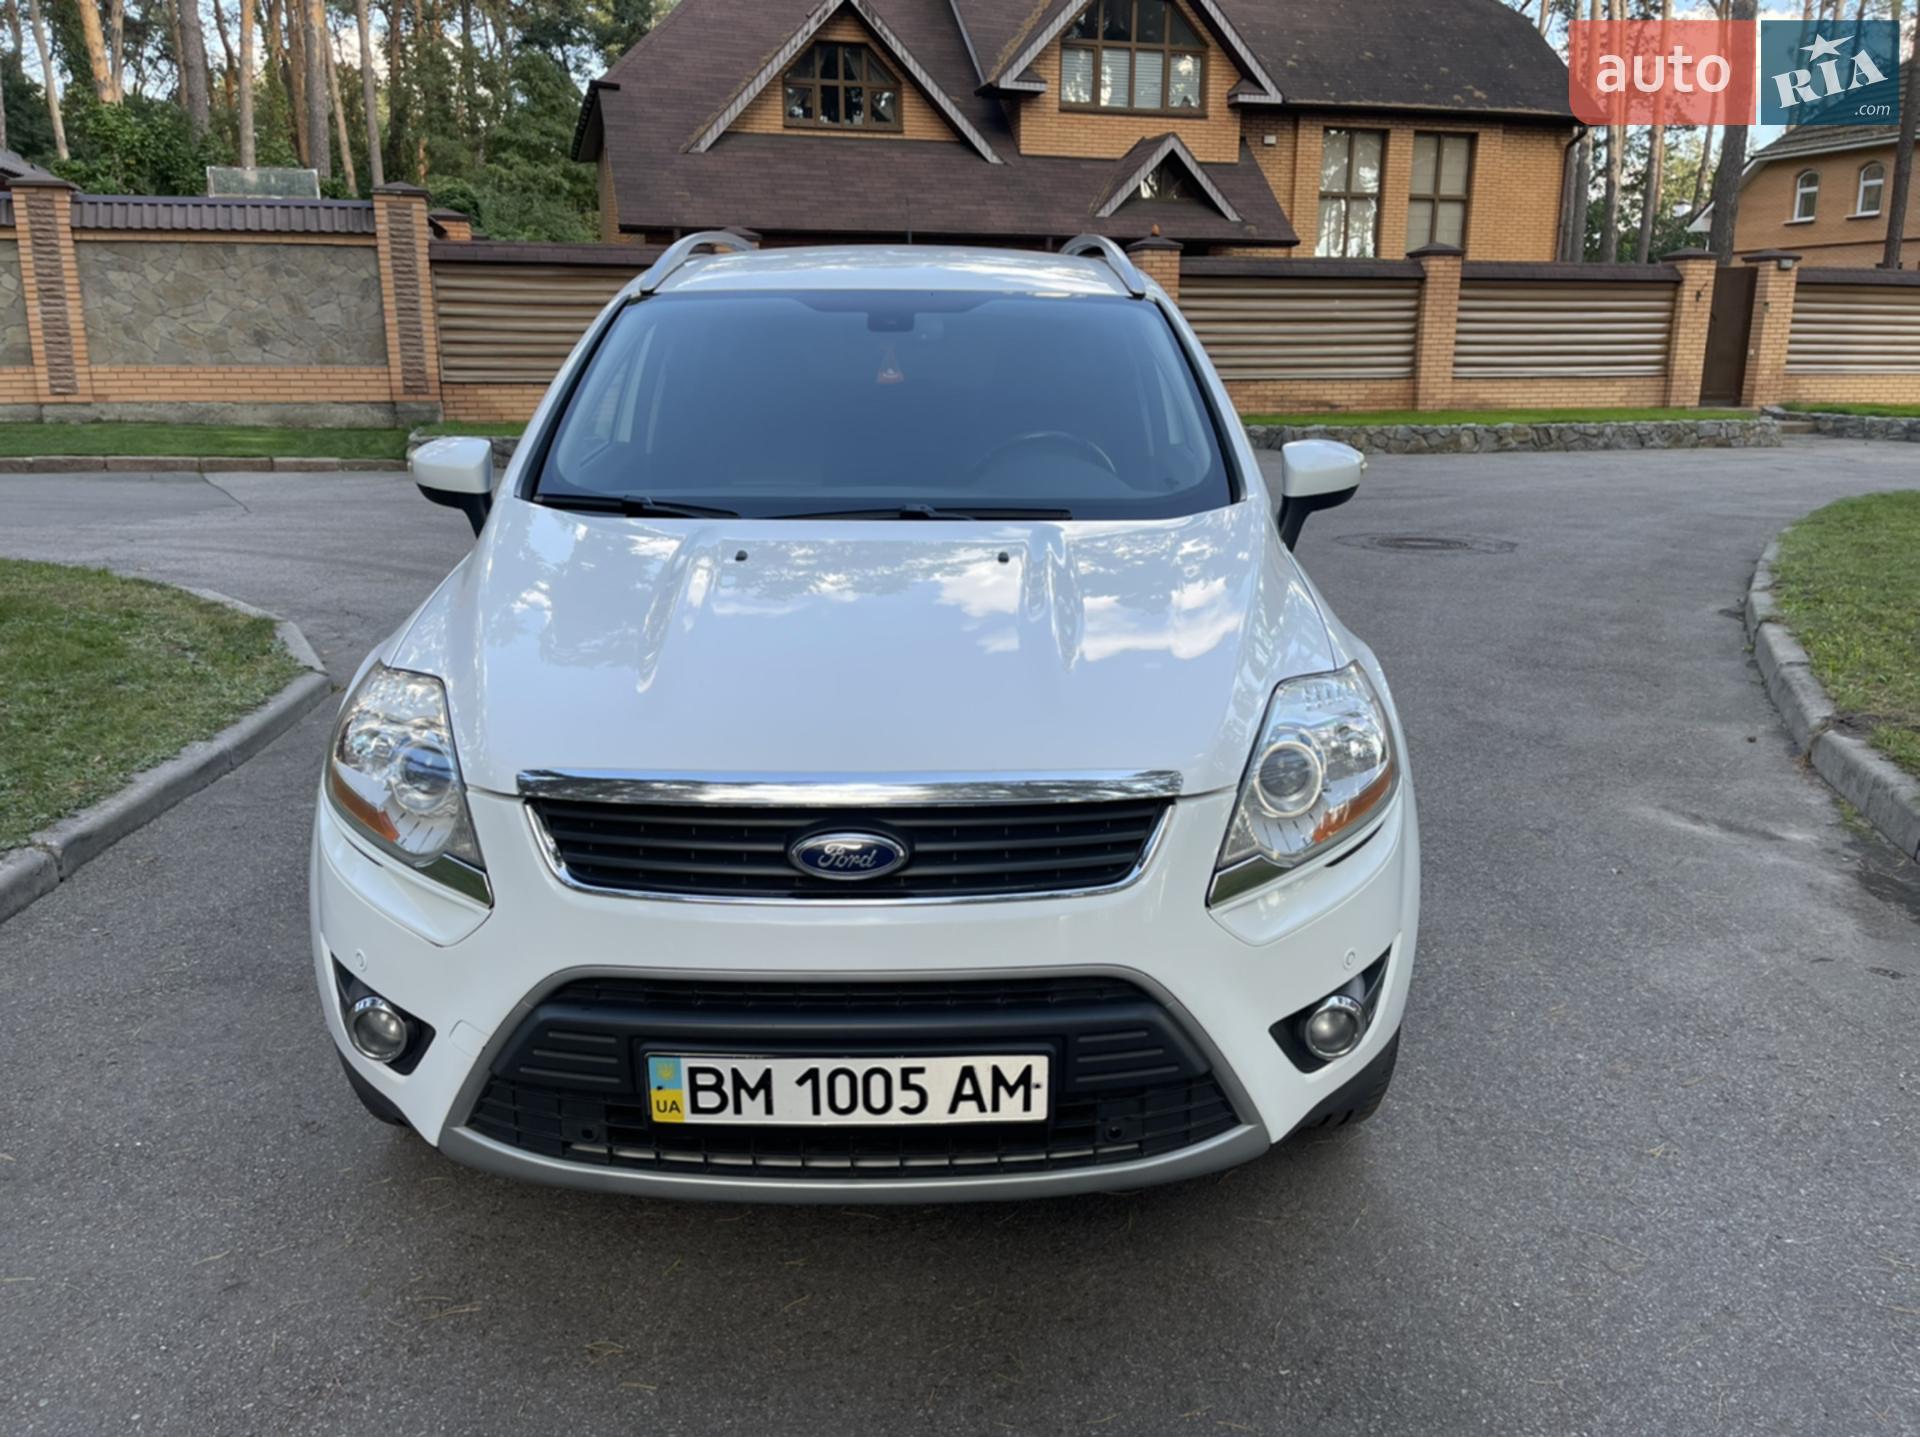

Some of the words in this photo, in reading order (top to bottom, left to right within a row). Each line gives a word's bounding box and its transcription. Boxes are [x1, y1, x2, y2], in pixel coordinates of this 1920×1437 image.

[817, 843, 878, 868] Ford
[687, 1065, 774, 1116] BM
[795, 1066, 929, 1116] 1005
[947, 1064, 1032, 1115] AM
[656, 1099, 681, 1114] UA
